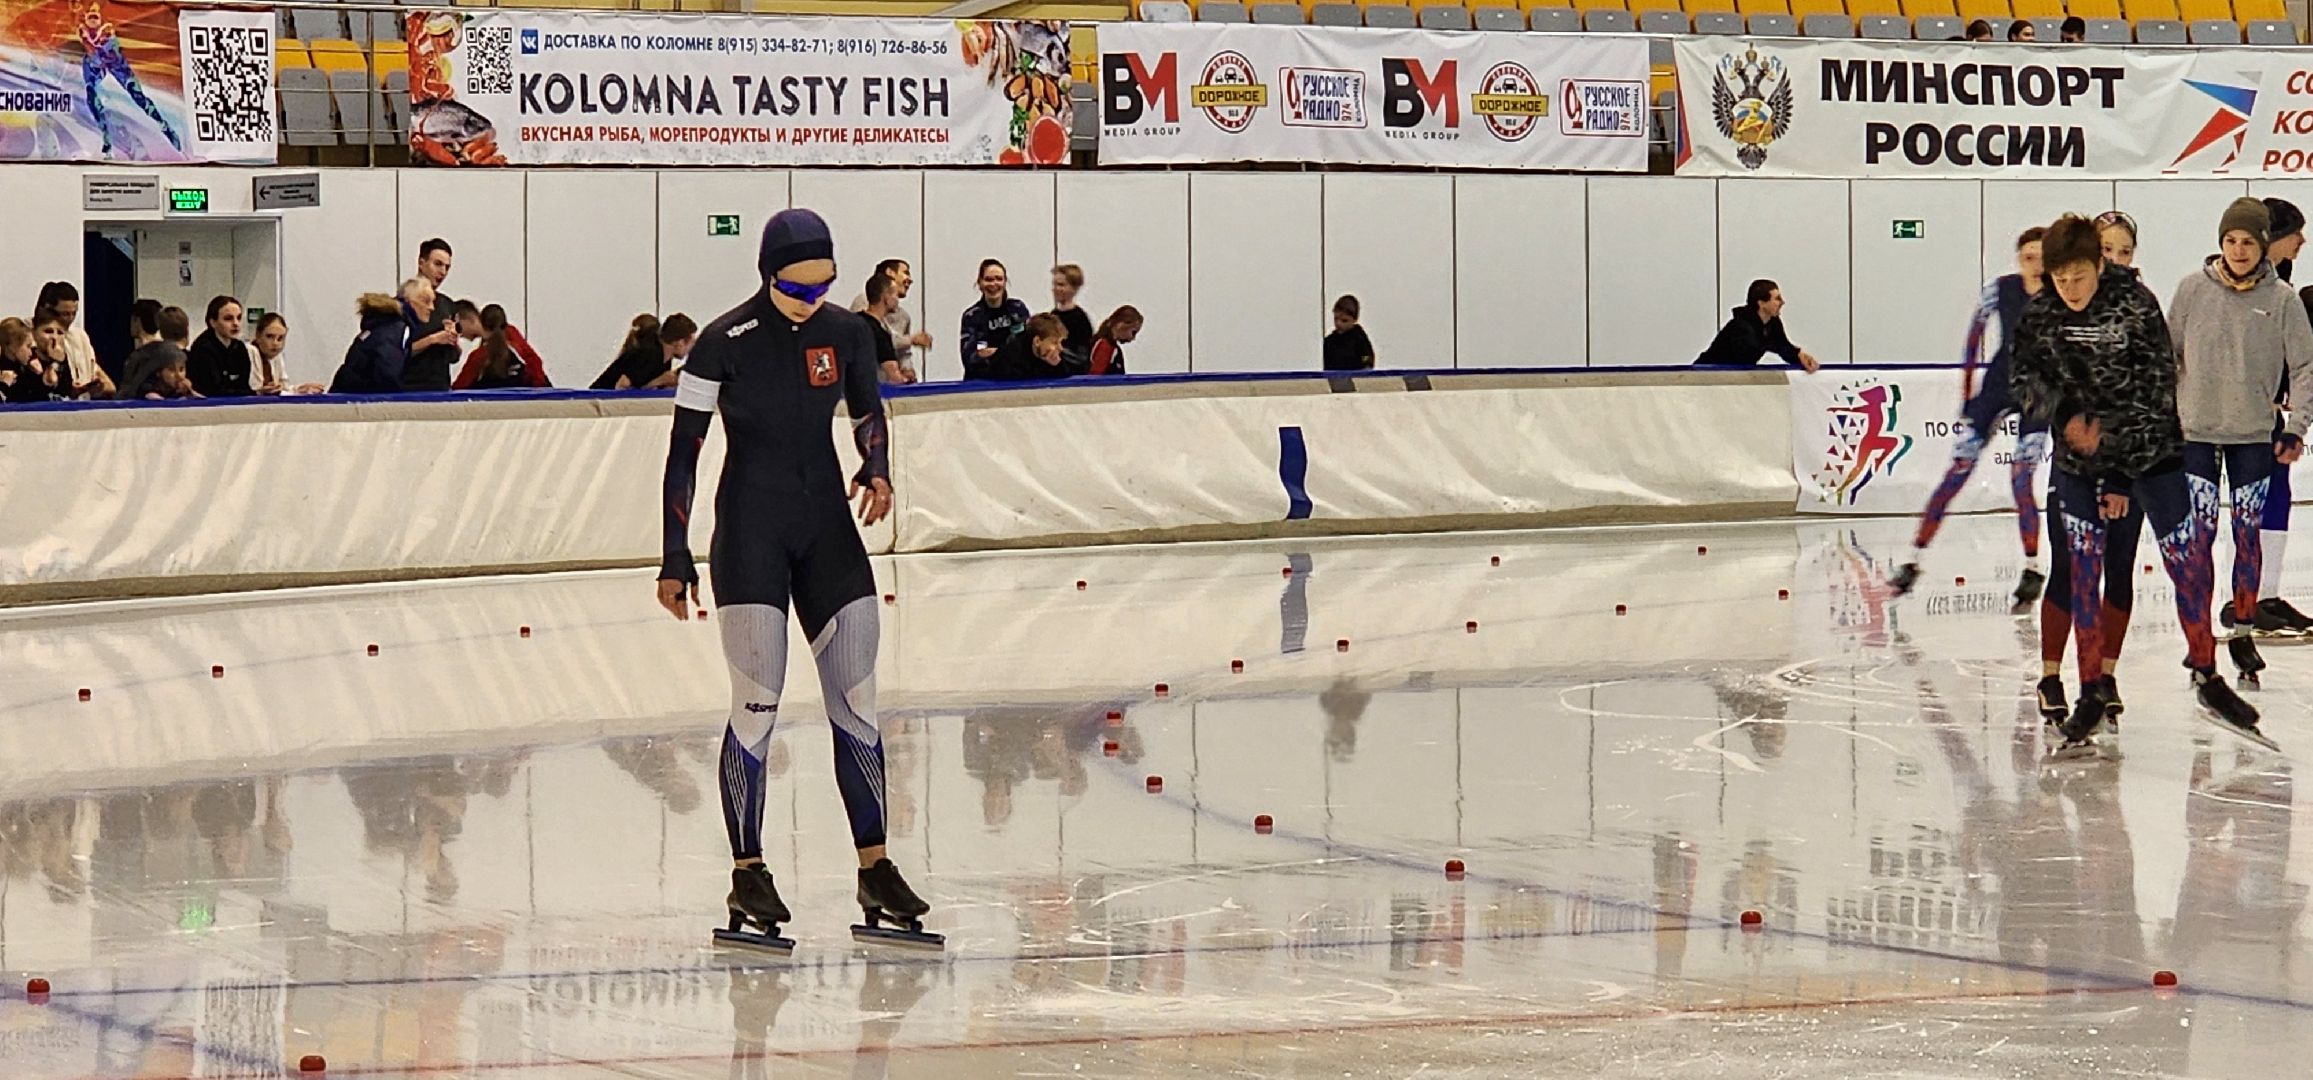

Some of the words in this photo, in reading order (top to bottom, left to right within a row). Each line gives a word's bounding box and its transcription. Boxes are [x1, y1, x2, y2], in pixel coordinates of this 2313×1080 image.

[543, 34, 617, 51] ДОСТАВКА
[620, 35, 642, 50] ПО
[646, 36, 713, 51] КОЛОМНЕ
[717, 37, 758, 56] 8(915)
[762, 38, 834, 55] 334-82-71;
[837, 39, 877, 56] 8(916)
[881, 40, 948, 55] 726-86-56
[519, 73, 723, 116] KOLOMNA
[732, 76, 848, 116] TASTY
[862, 77, 949, 117] FISH
[1303, 74, 1350, 97] РУССКОЕ
[1820, 59, 2125, 109] МИНСПОРТ
[1585, 86, 1631, 107] РУССКОЕ
[1302, 99, 1340, 121] РАДИО
[1586, 108, 1620, 131] РАДИО
[521, 126, 594, 142] ВКУСНАЯ
[599, 126, 645, 144] РЫБА,
[649, 127, 771, 146] МОРЕПРОДУКТЫ
[775, 127, 787, 143] И
[792, 127, 848, 146] ДРУГИЕ
[853, 128, 949, 146] ДЕЛИКАТЕСЫ
[1104, 127, 1137, 137] MEDIA
[1143, 127, 1181, 136] GROUP
[1423, 131, 1460, 140] GROUP
[1865, 122, 2086, 168] РОССИИ
[1924, 421, 1949, 438] ПО
